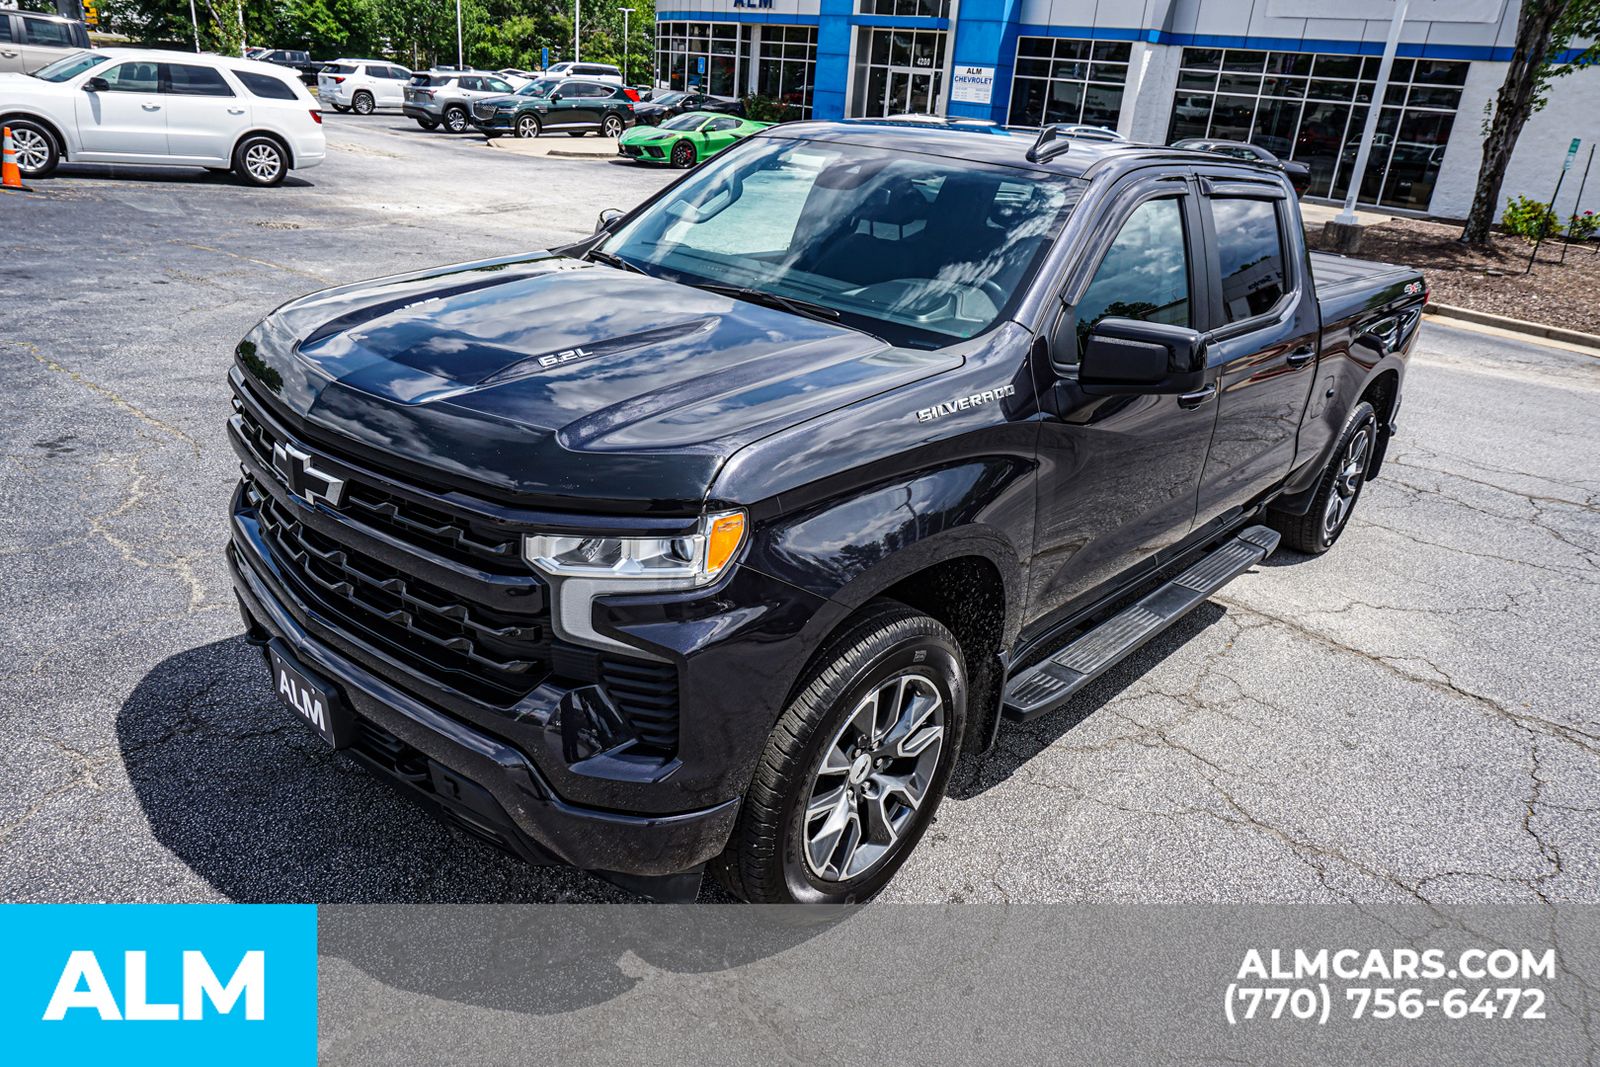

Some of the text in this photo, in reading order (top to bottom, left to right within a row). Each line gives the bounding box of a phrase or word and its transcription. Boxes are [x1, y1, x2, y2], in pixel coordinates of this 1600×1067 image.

[733, 0, 773, 8] ALM
[966, 67, 982, 75] ALM
[954, 75, 993, 85] CHEVROLET
[537, 348, 593, 368] 6.2L
[917, 384, 1016, 423] SILVERADO
[280, 669, 326, 732] ALM
